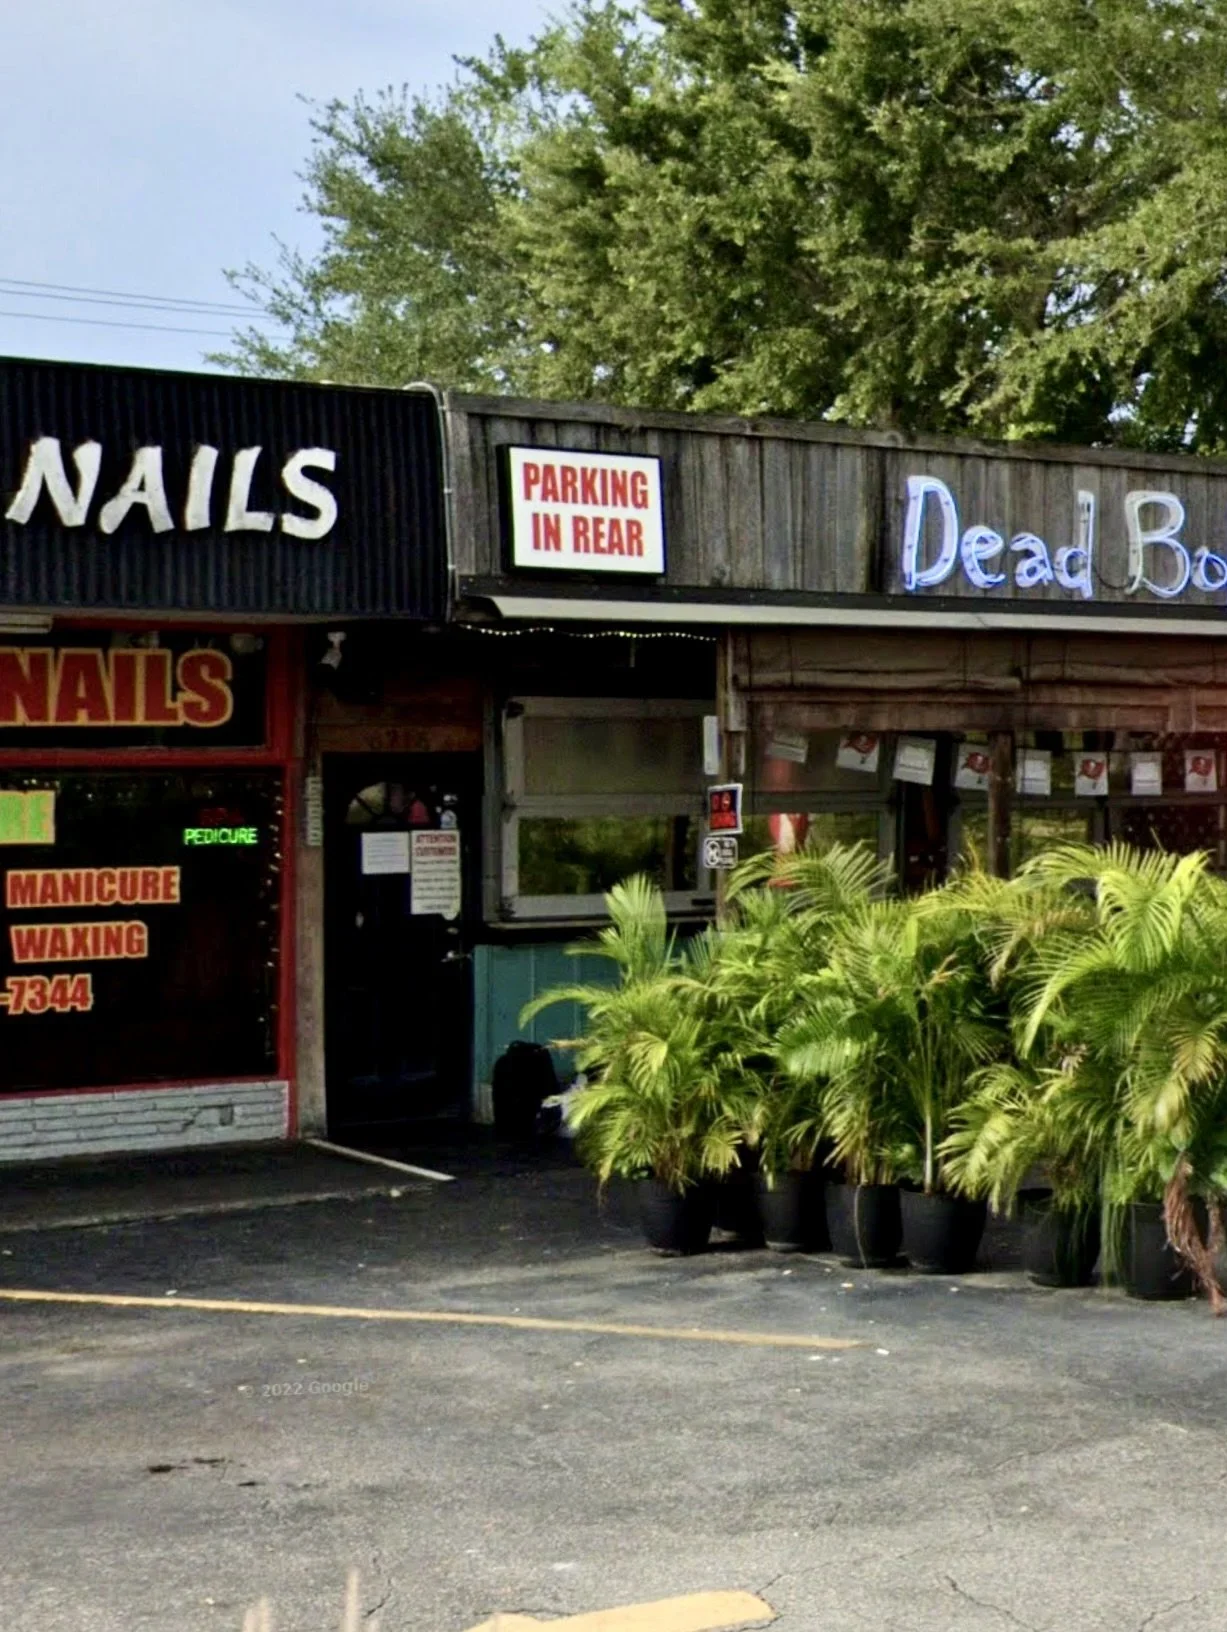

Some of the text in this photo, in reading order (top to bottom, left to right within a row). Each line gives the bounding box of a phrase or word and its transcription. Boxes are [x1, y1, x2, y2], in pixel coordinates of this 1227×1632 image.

[5, 436, 338, 540] NAILS
[522, 461, 649, 510] PARKING
[531, 511, 645, 558] IN REAR
[903, 474, 1095, 599] Dead
[0, 646, 233, 729] NAILS
[183, 827, 259, 846] PEDICURE
[7, 866, 181, 908] MANICURE
[10, 921, 148, 962] WAXING
